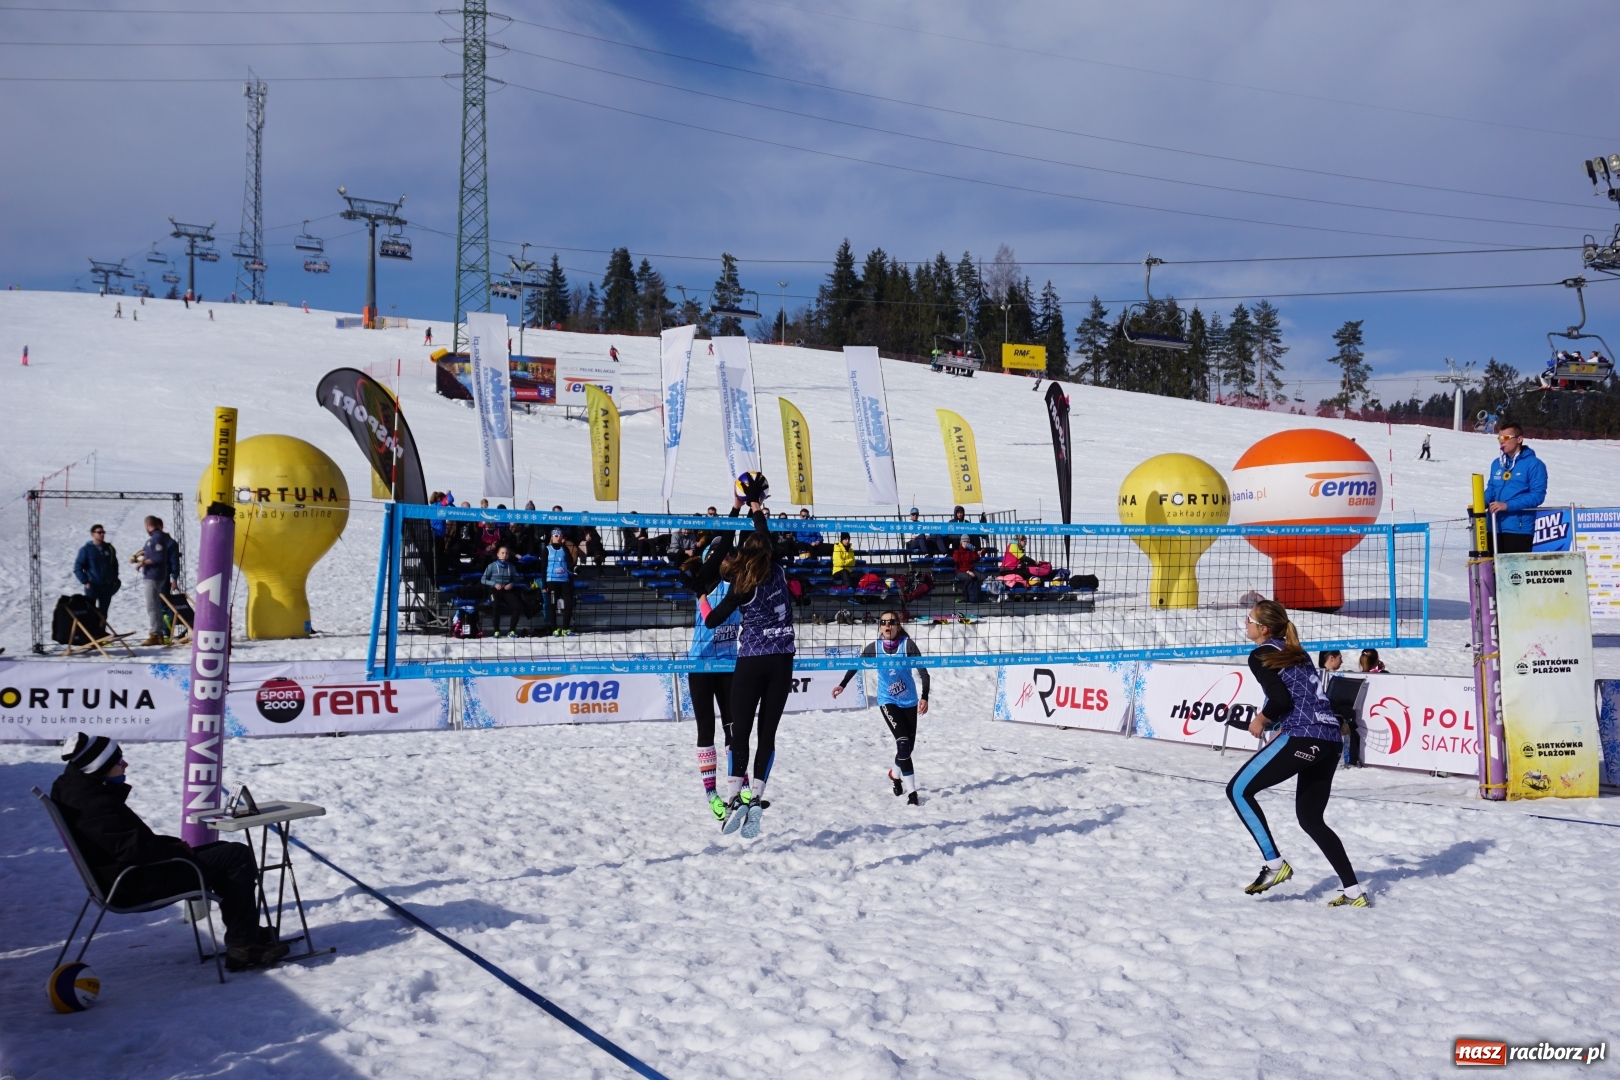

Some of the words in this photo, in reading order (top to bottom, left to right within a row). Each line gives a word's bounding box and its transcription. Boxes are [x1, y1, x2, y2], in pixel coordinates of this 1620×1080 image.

[1014, 349, 1030, 358] RMF
[563, 377, 614, 394] Tea
[217, 428, 229, 475] SPORT
[1305, 472, 1376, 498] Terma
[236, 487, 338, 502] ORTUNA
[293, 508, 332, 518] online
[1167, 508, 1206, 518] zakłady
[1534, 512, 1561, 530] OW
[1532, 523, 1567, 544] LLEY
[1525, 568, 1572, 576] SIATKÓWKA
[194, 630, 225, 701] BDB
[1532, 657, 1579, 666] SIATKÓWKA
[260, 690, 300, 700] SPORT
[511, 674, 620, 703] Terma
[1033, 668, 1108, 718] RULES
[0, 687, 155, 709] ORTUNA
[264, 700, 298, 710] 2000
[312, 681, 398, 716] rent
[1170, 700, 1257, 722] rhSPORT
[1, 715, 32, 725] łady
[41, 715, 150, 724] bukmacherskie
[1536, 740, 1583, 749] SIATKÓWKA
[1538, 748, 1576, 757] PLAŻOWA
[186, 714, 220, 824] EVEN
